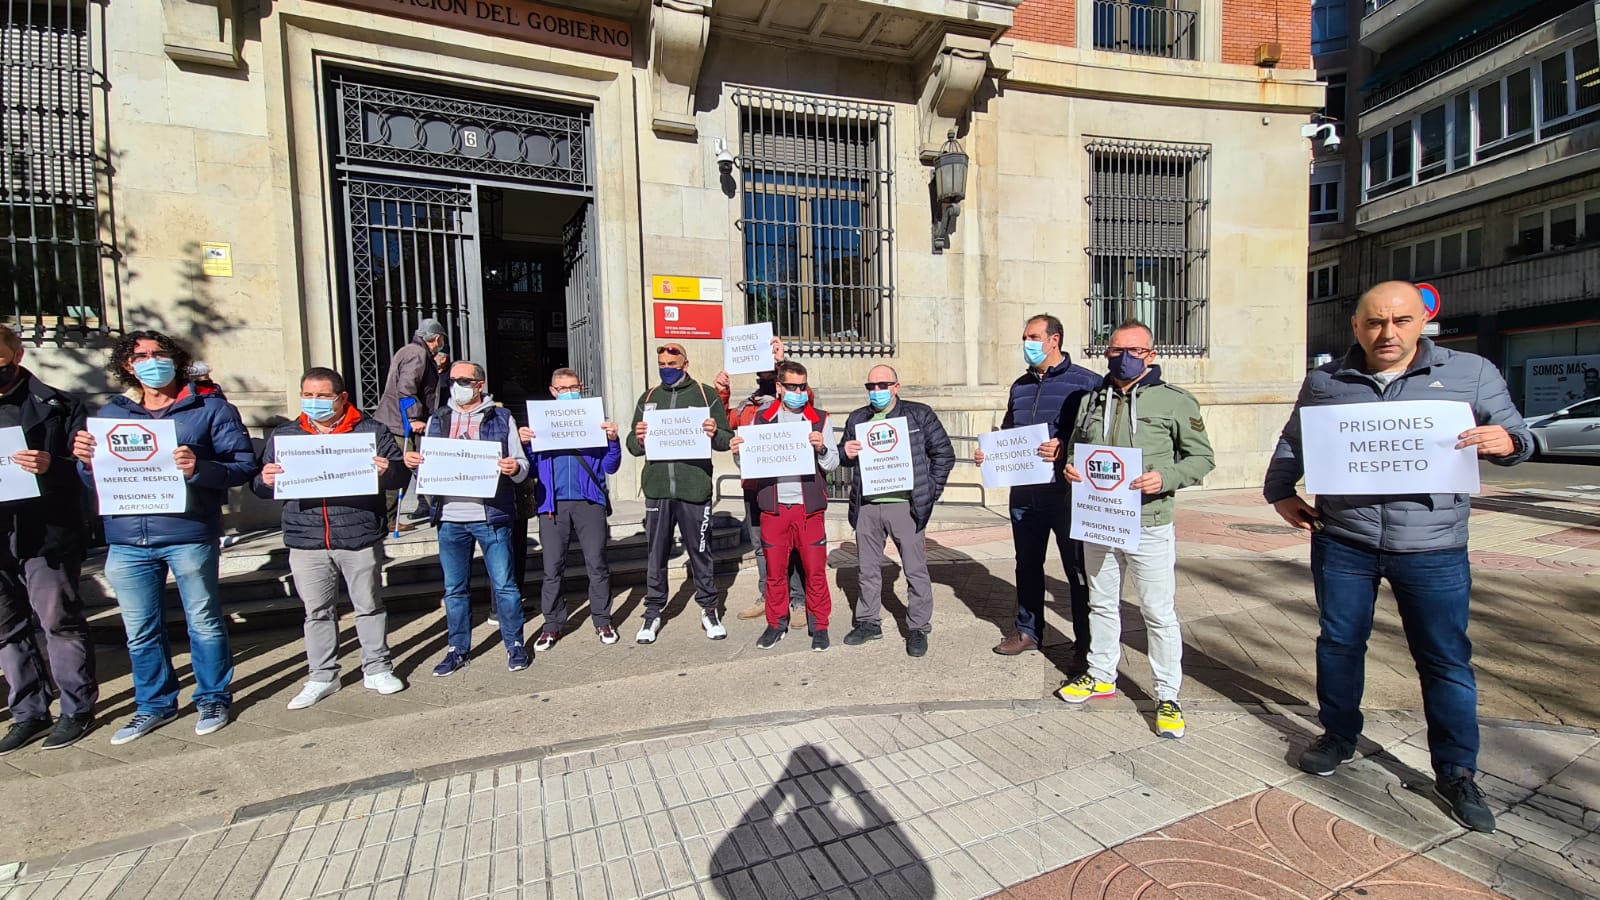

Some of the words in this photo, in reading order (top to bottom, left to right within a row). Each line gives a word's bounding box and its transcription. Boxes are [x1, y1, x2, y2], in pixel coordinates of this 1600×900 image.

[475, 1, 520, 26] DEL
[527, 12, 630, 47] GOBIERNO
[466, 132, 476, 146] 6
[727, 333, 758, 342] PRISIONES
[732, 355, 759, 363] RESPETO
[1533, 364, 1564, 376] SOMOS
[545, 408, 586, 417] PRISIONES
[551, 420, 584, 428] MERECE
[1340, 417, 1434, 432] PRISIONES
[773, 430, 791, 439] MÁS
[660, 439, 696, 447] PRISIONES
[1010, 436, 1028, 446] MÁS
[1350, 439, 1424, 452] MERECE
[746, 443, 793, 453] AGRESIONES
[757, 455, 796, 464] PRISIONES
[985, 449, 1031, 461] AGRESIONES
[995, 462, 1034, 472] PRISIONES
[1348, 459, 1428, 472] RESPETO
[1090, 472, 1120, 480] AGRESIONES
[1088, 494, 1122, 504] PRISIONES
[118, 503, 169, 511] AGRESIONES
[1077, 503, 1101, 512] MERECE
[1105, 507, 1136, 517] RESPETO
[699, 506, 710, 552] GIVOVA
[1081, 521, 1115, 532] PRISIONES
[1118, 527, 1130, 535] SIN
[1084, 531, 1125, 544] AGRESIONES
